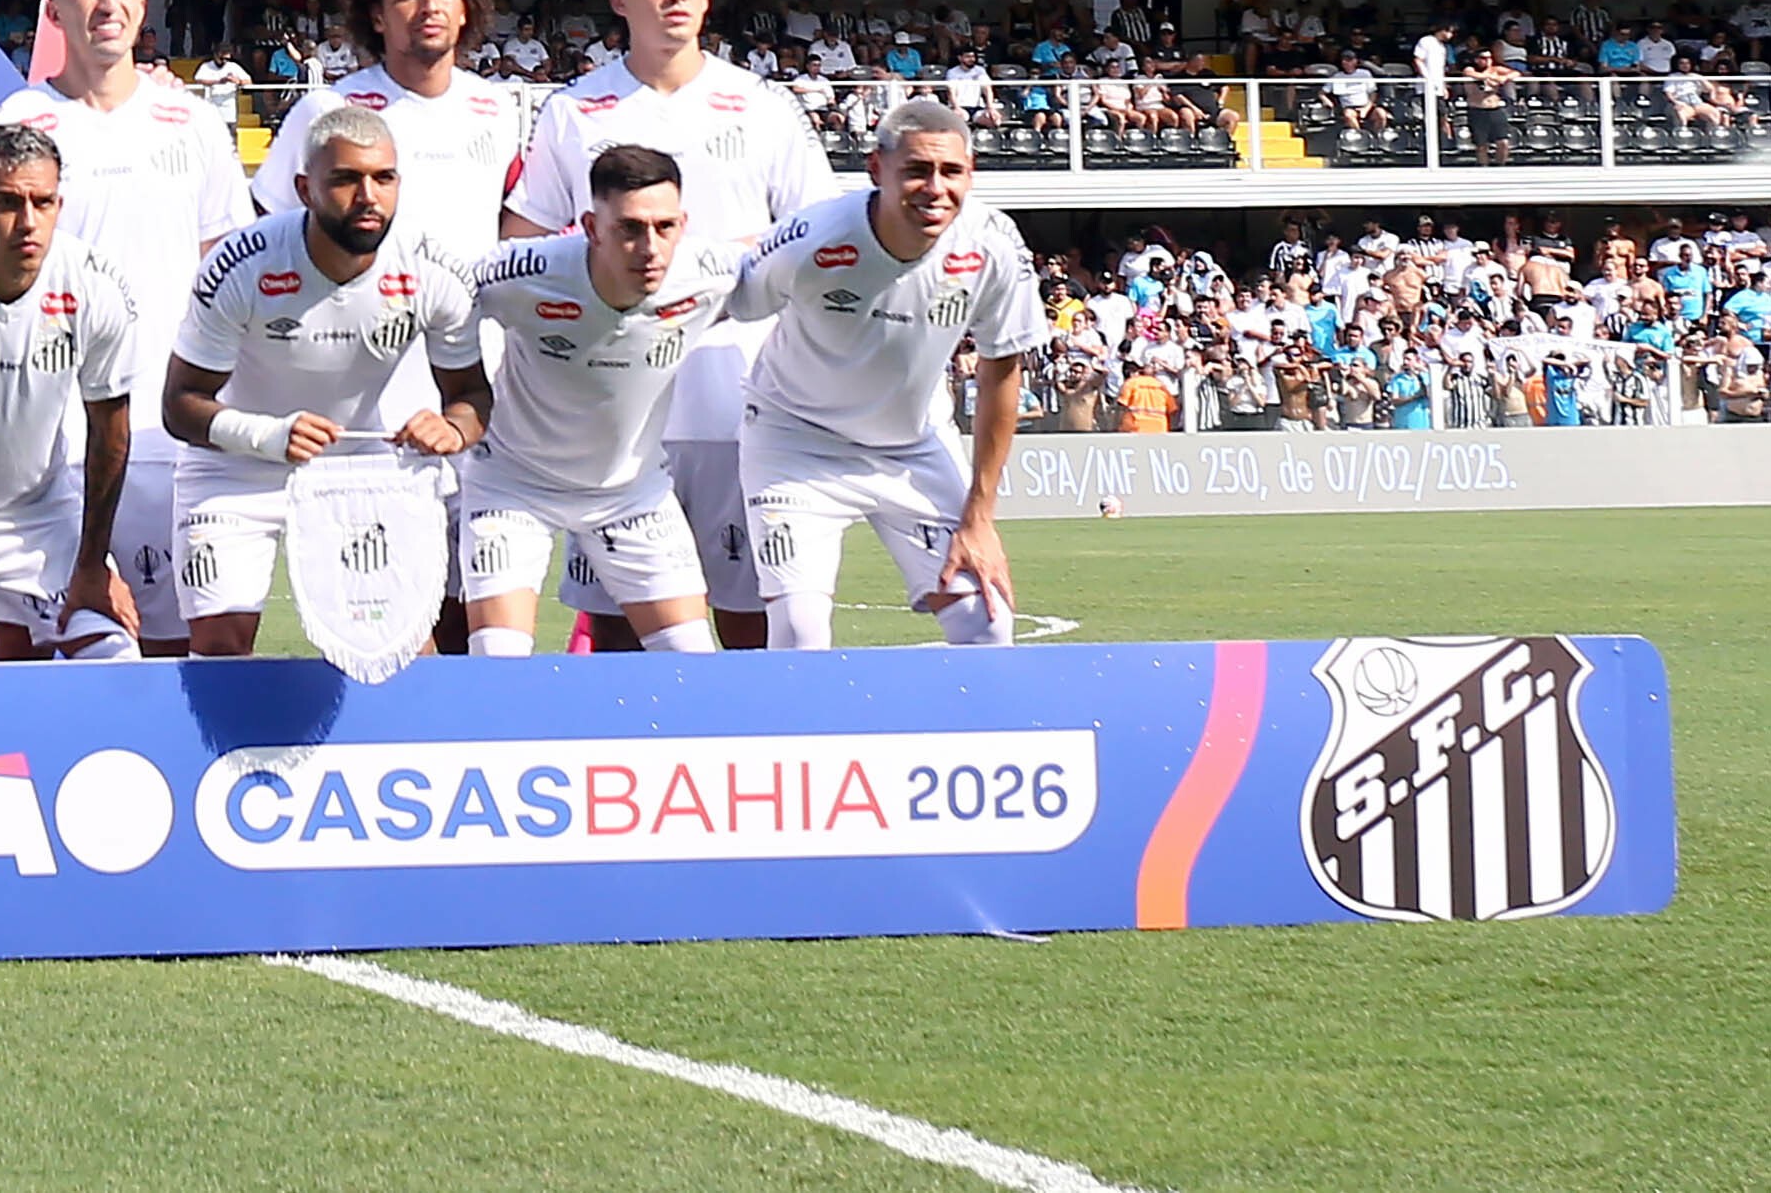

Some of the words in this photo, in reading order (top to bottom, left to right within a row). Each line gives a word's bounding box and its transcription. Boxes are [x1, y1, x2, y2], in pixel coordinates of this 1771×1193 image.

[1025, 446, 1139, 506] SPA/MF
[1148, 448, 1191, 496] No
[1199, 445, 1270, 502] 250,
[1277, 442, 1315, 494] de
[1323, 441, 1518, 503] 07/02/2025.
[1334, 644, 1556, 841] S.F.C.
[907, 762, 1069, 823] 2026
